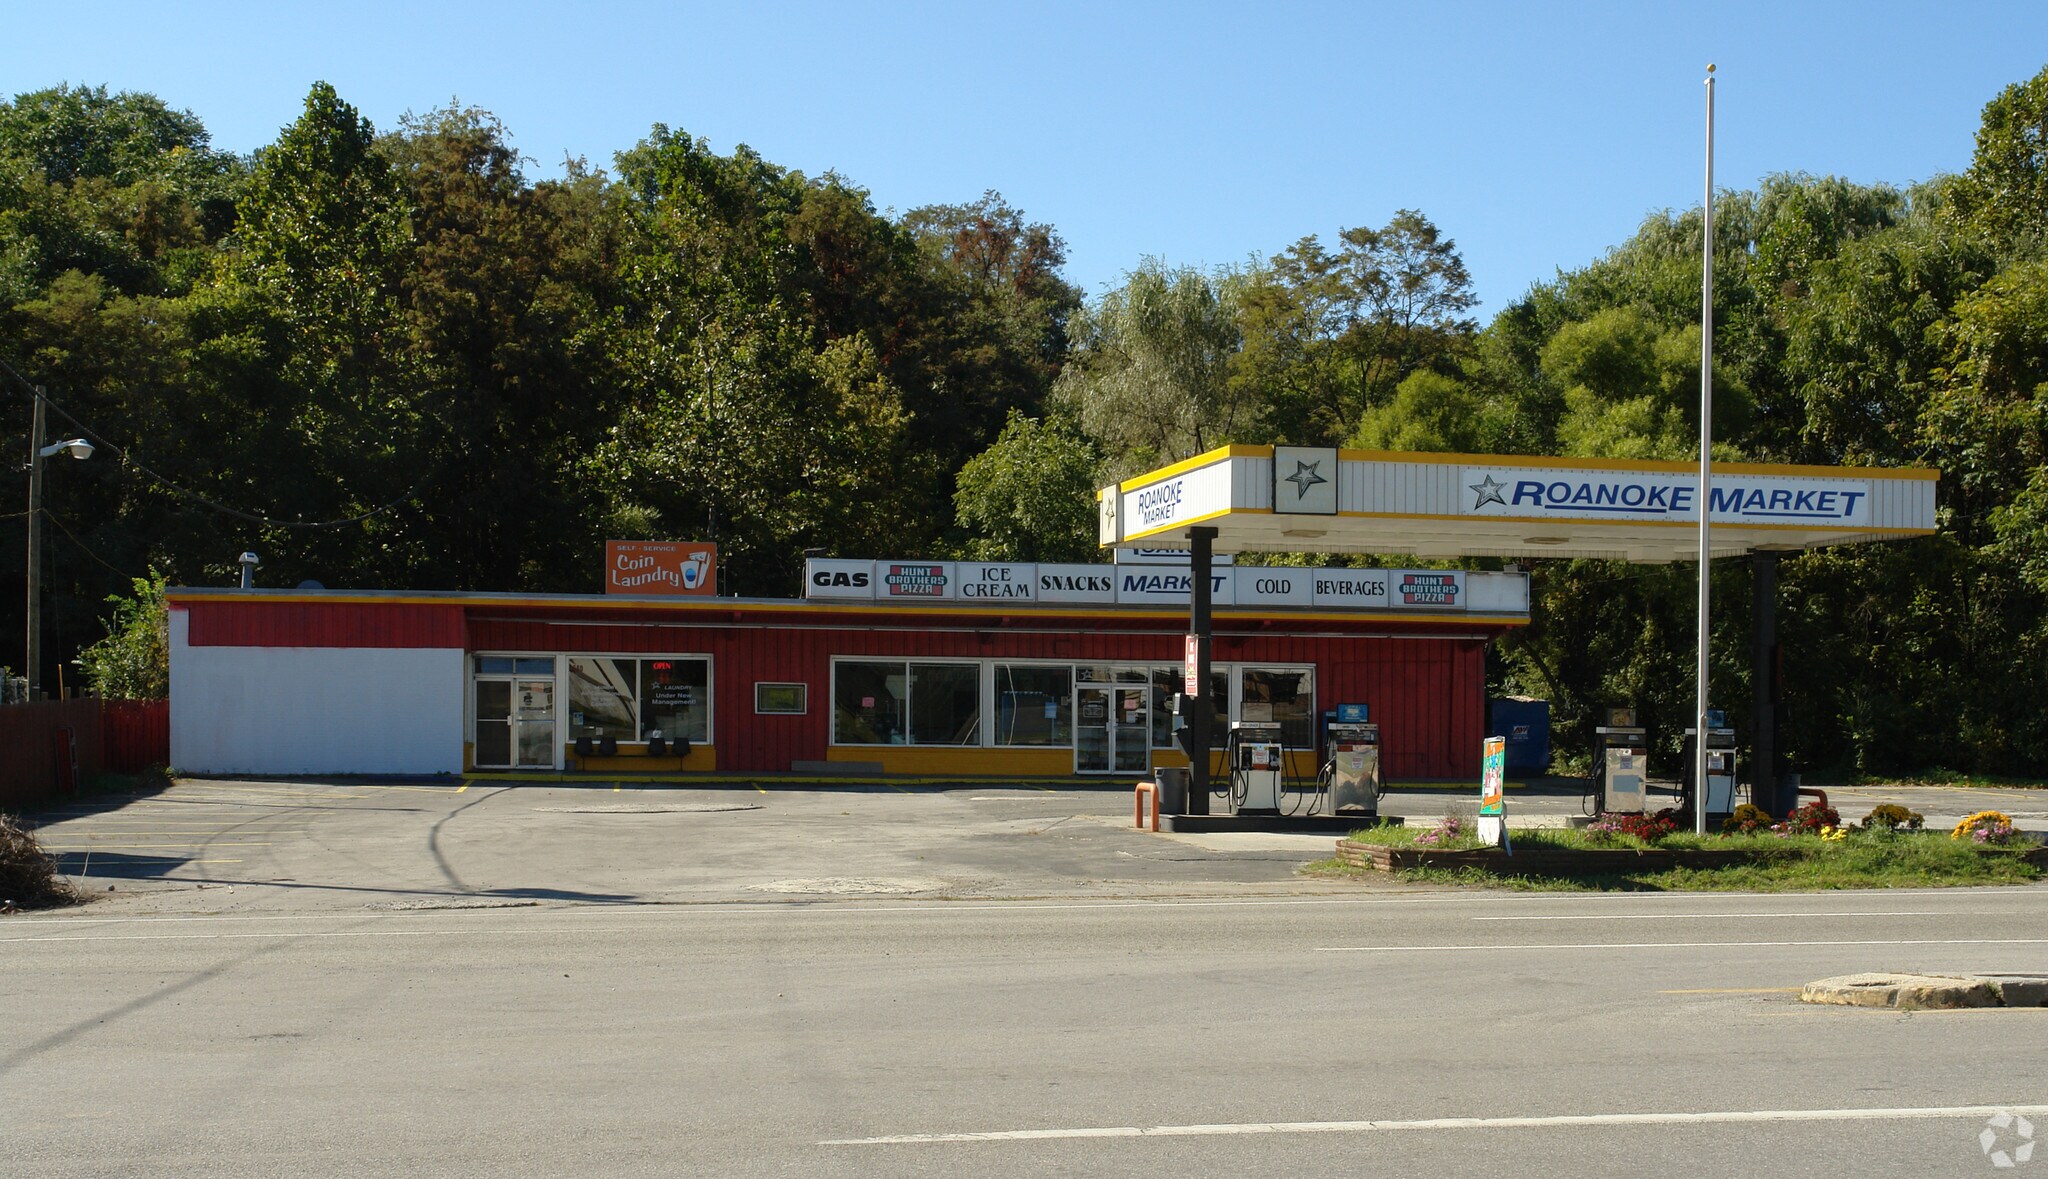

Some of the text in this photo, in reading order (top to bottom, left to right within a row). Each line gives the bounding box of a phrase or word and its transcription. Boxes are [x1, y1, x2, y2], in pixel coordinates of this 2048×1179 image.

[1138, 480, 1182, 515] ROANOKE
[1511, 480, 1865, 517] ROANOKE MARKET
[1143, 502, 1176, 525] MARKET
[617, 554, 654, 570] Coin
[612, 566, 679, 587] Laundry
[813, 571, 869, 587] GAS
[901, 567, 932, 576] HUNT
[982, 568, 1011, 582] ICE
[889, 575, 945, 585] BROTHERS
[1041, 575, 1112, 592] SNACKS
[1123, 575, 1227, 593] MARKT
[1256, 578, 1291, 594] COLD
[1316, 580, 1385, 596] BEVERAGES
[1414, 576, 1444, 585] HUNT
[901, 584, 933, 594] PIZZA
[963, 583, 1030, 597] CREAM
[1402, 585, 1456, 594] BROTHERS
[1414, 593, 1445, 602] PIZZA
[652, 662, 671, 670] OPEN
